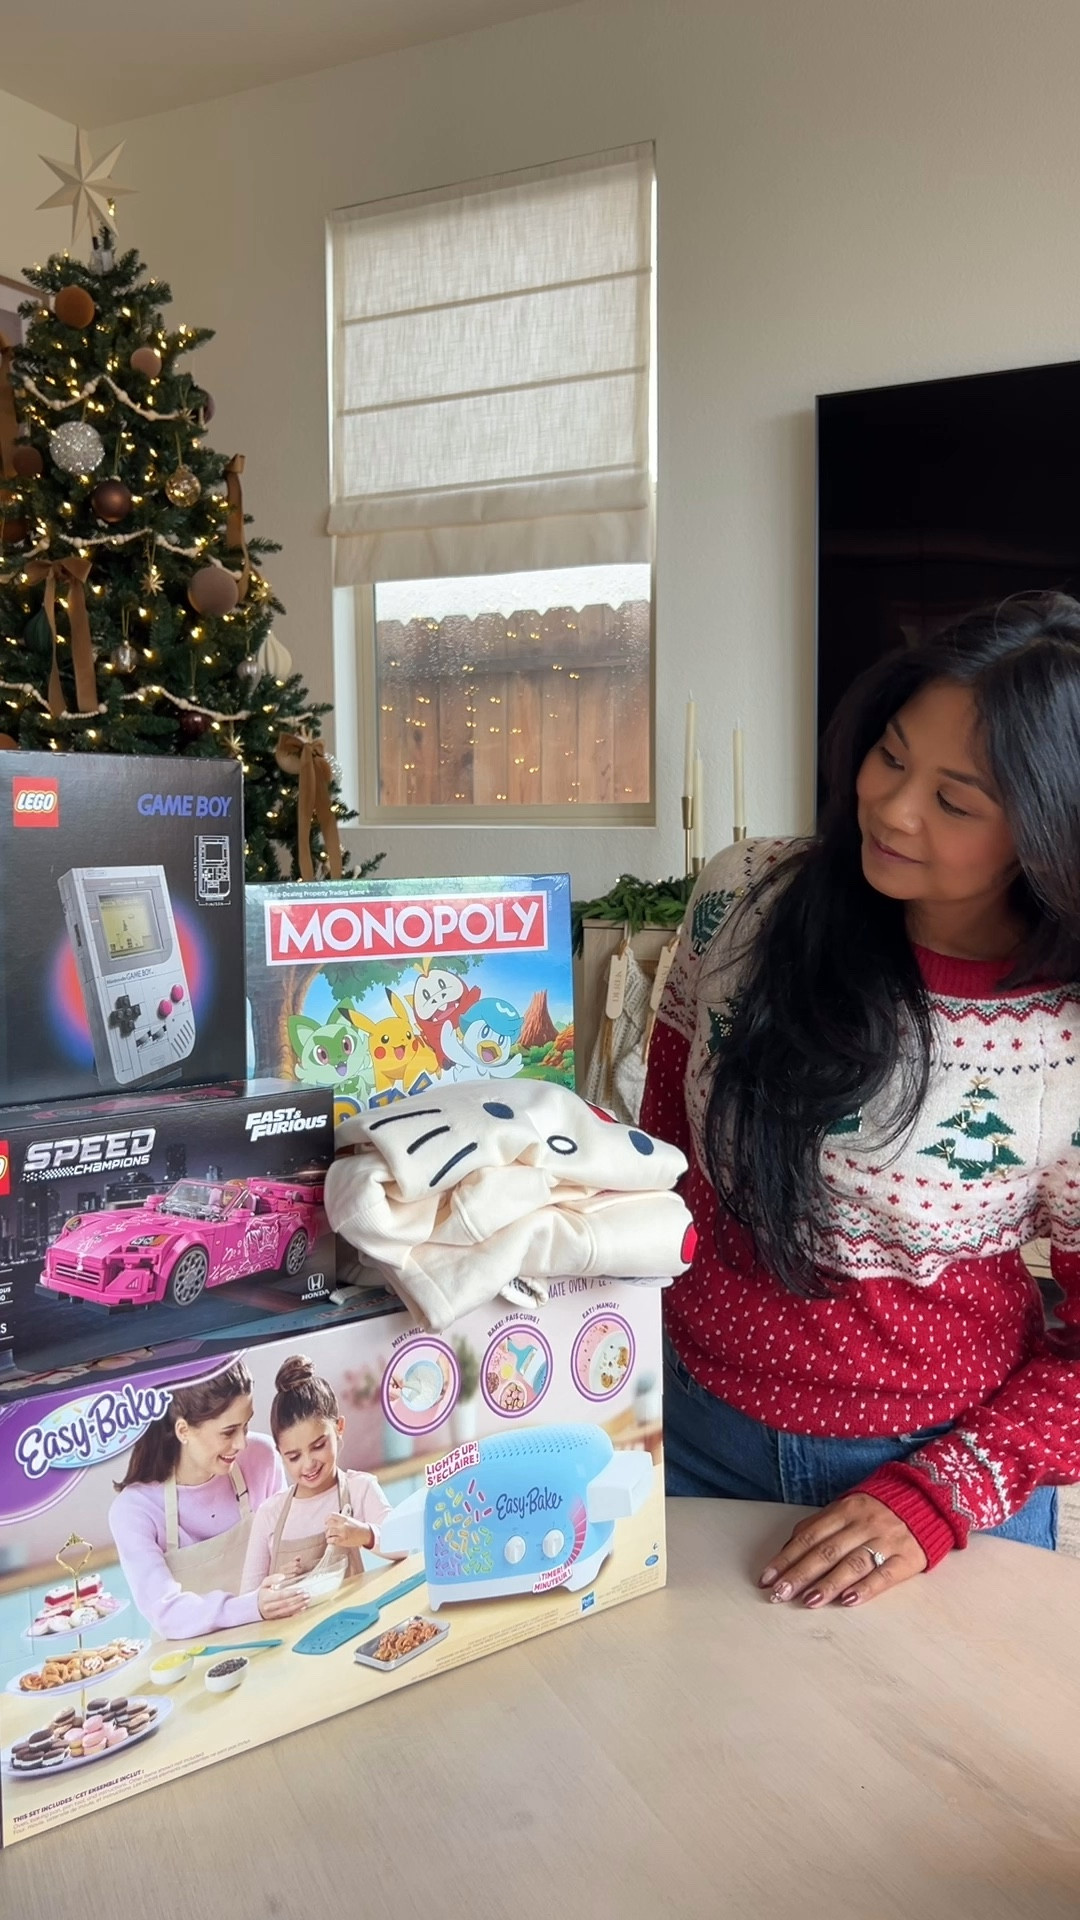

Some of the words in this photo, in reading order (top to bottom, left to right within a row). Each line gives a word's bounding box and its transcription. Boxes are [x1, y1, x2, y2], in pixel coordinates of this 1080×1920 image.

[15, 790, 57, 812] LEGO
[137, 793, 193, 816] GAME
[196, 795, 232, 817] BOY
[278, 901, 539, 954] MONOPOLY
[250, 1114, 328, 1142] FURIOUS
[23, 1127, 156, 1171] SPEED
[301, 1289, 330, 1300] HONDA
[568, 1277, 587, 1294] OVEN
[426, 1449, 460, 1475] LIGHTS
[461, 1442, 477, 1455] UP!
[13, 1813, 28, 1823] THIS
[28, 1808, 41, 1817] SET
[88, 1778, 119, 1795] ENSEMBLE
